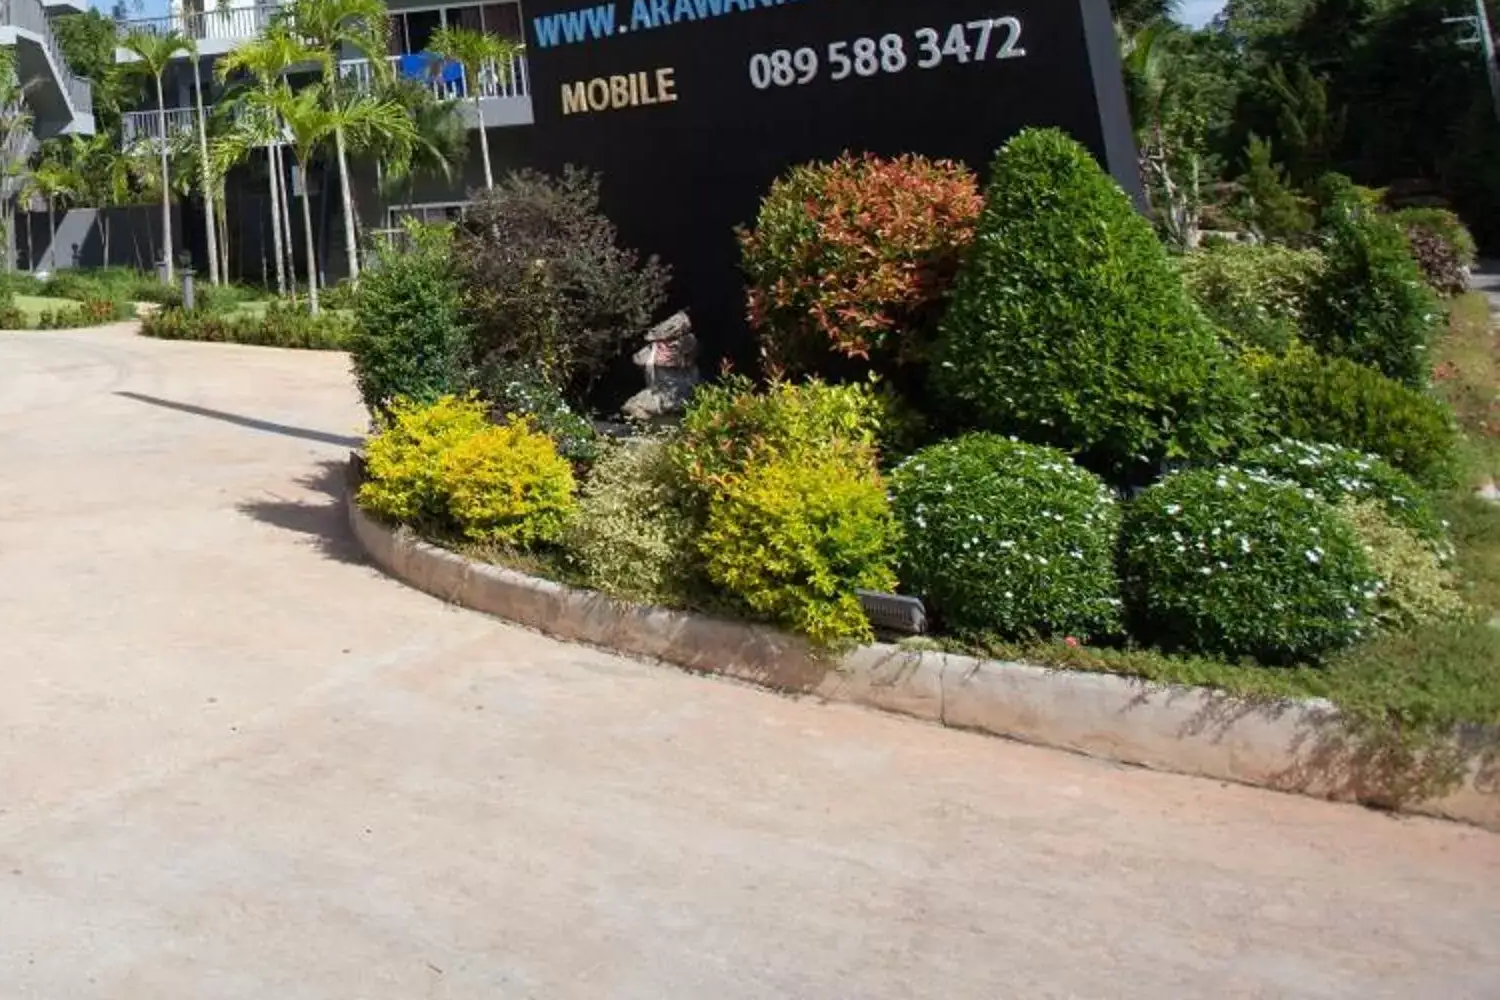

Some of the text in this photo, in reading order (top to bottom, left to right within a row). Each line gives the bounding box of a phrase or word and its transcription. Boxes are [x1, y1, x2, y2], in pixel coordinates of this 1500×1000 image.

[562, 16, 1027, 114] MOBILE 089 588 3472
